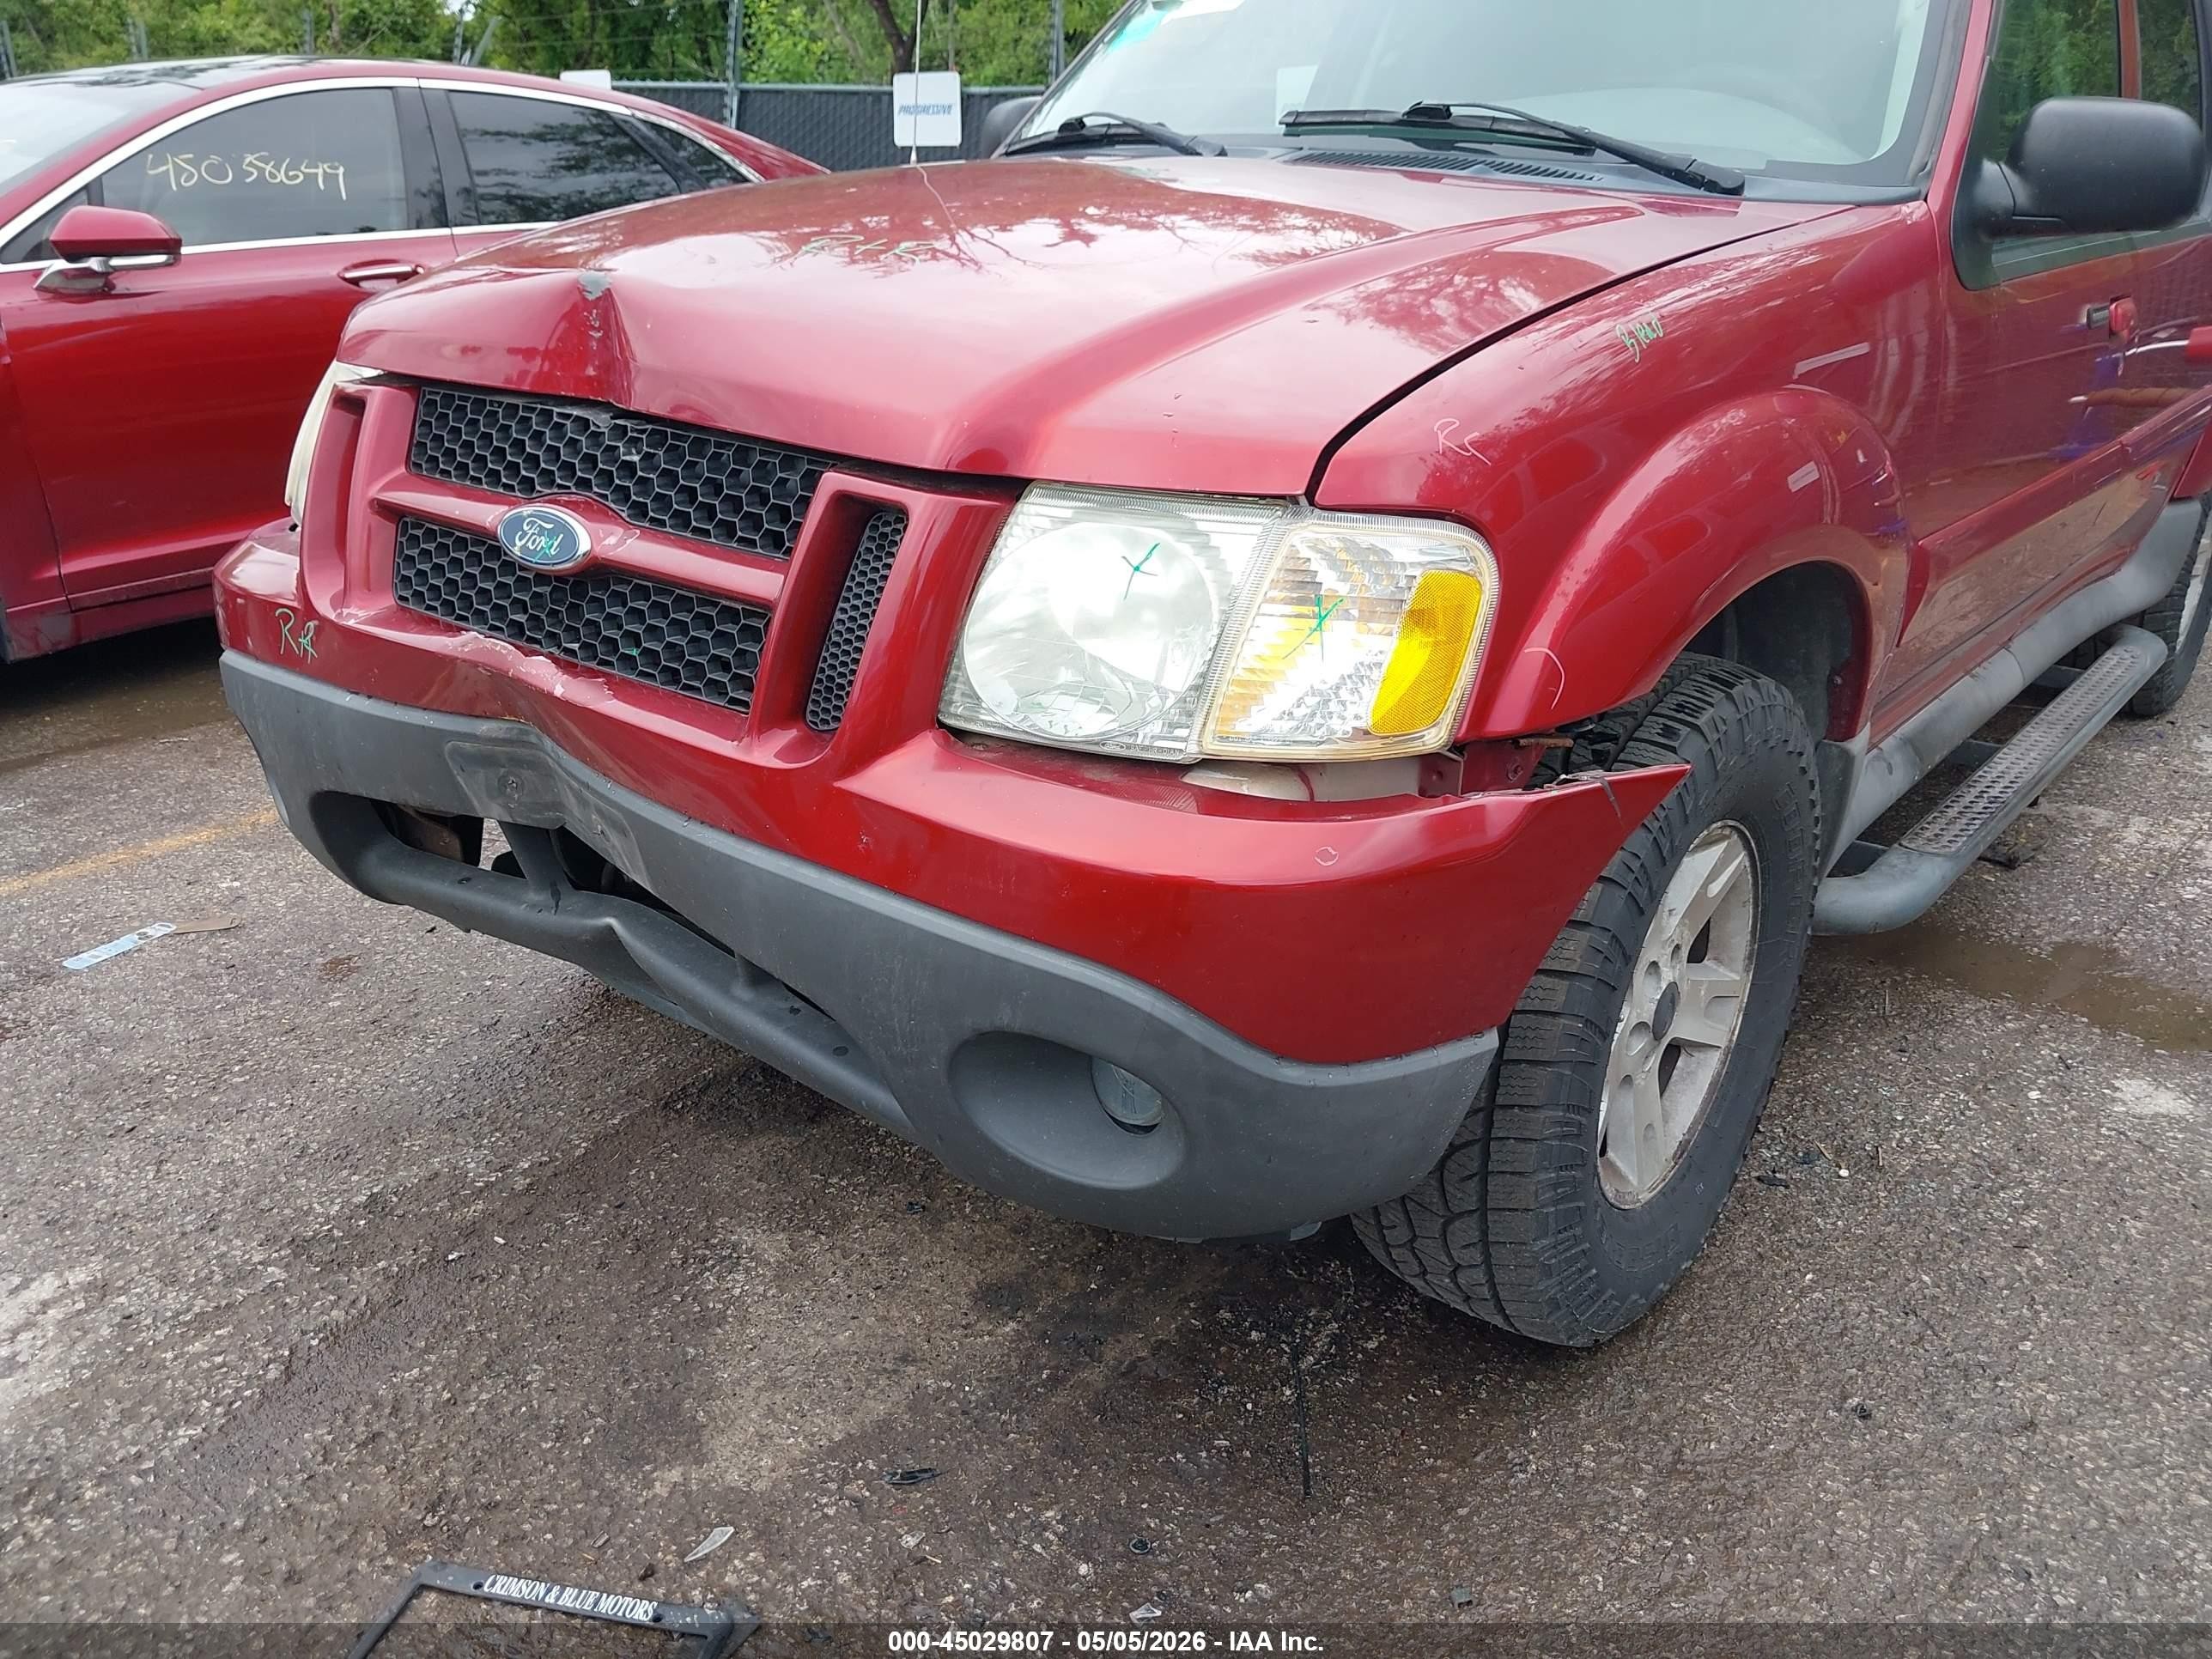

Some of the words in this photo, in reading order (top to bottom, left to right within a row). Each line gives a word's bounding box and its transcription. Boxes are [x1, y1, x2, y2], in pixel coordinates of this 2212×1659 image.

[514, 517, 564, 556] Ford
[483, 1574, 550, 1601] CRIMSON
[544, 1584, 561, 1603] &
[557, 1586, 598, 1610] BLUE
[596, 1592, 659, 1621] MOTORS
